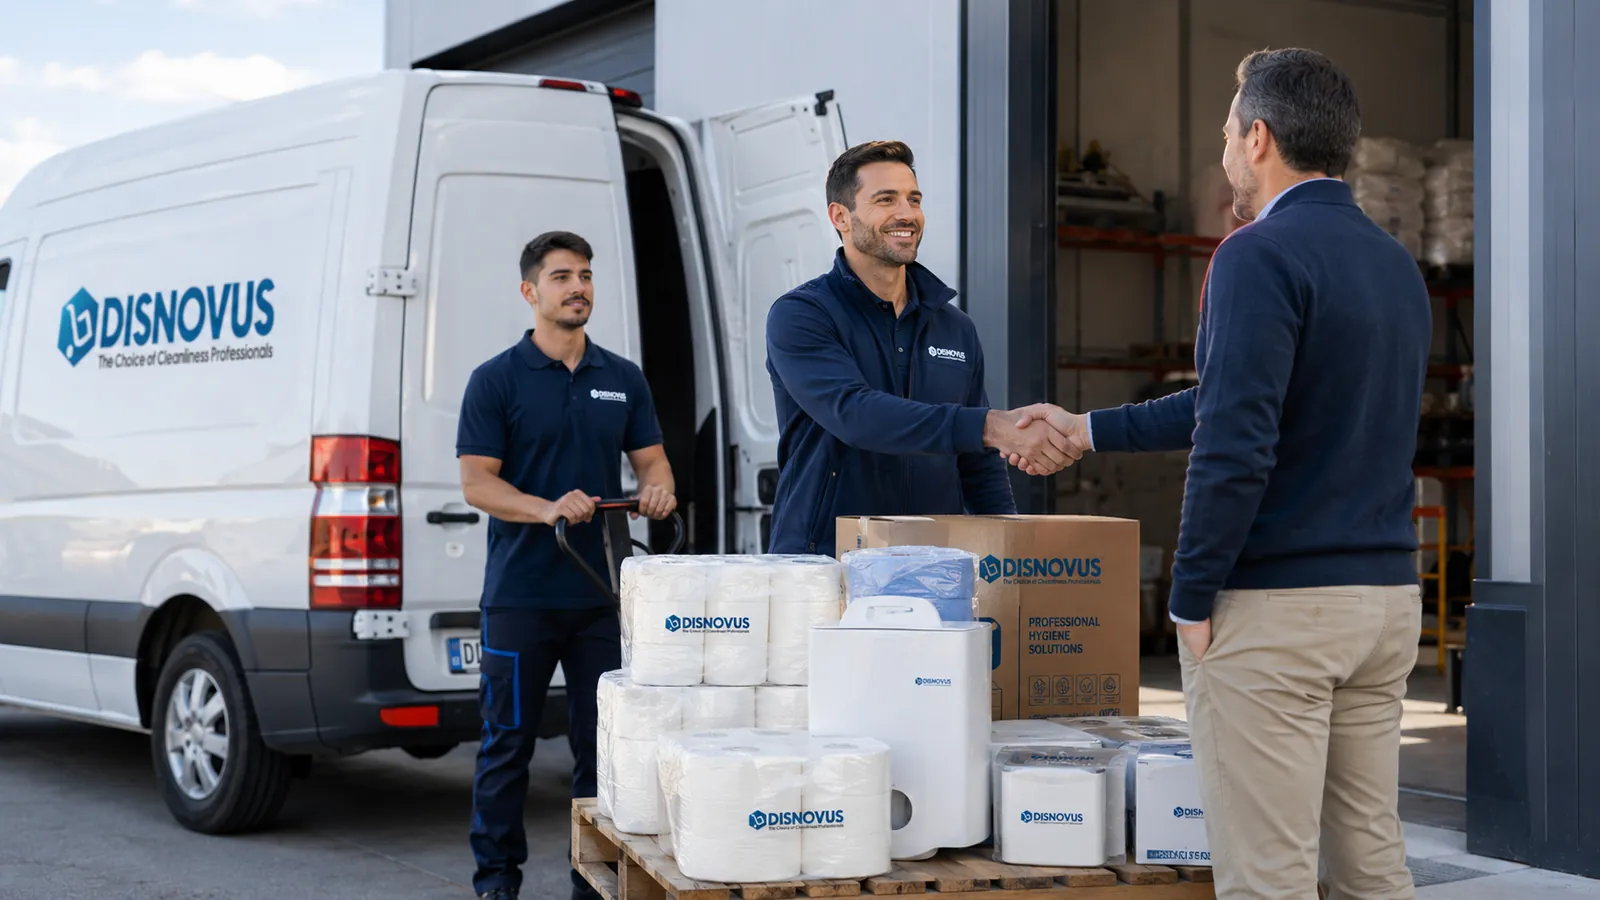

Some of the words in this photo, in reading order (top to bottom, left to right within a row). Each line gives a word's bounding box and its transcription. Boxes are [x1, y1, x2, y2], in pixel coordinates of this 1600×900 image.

[100, 278, 275, 348] DISNOVUS
[98, 353, 113, 369] The
[115, 352, 146, 368] Choice
[147, 350, 156, 366] of
[157, 347, 209, 365] Cleanliness
[211, 342, 273, 362] Professionals
[1003, 558, 1102, 577] DISNOVUS
[682, 617, 750, 629] DISNOVUS
[1028, 617, 1101, 628] PROFESSIONAL
[1028, 631, 1071, 641] HYGIENE
[1028, 643, 1083, 655] SOLUTIONS
[768, 809, 844, 826] DISNOVUS
[1033, 812, 1083, 822] DISNOVUS
